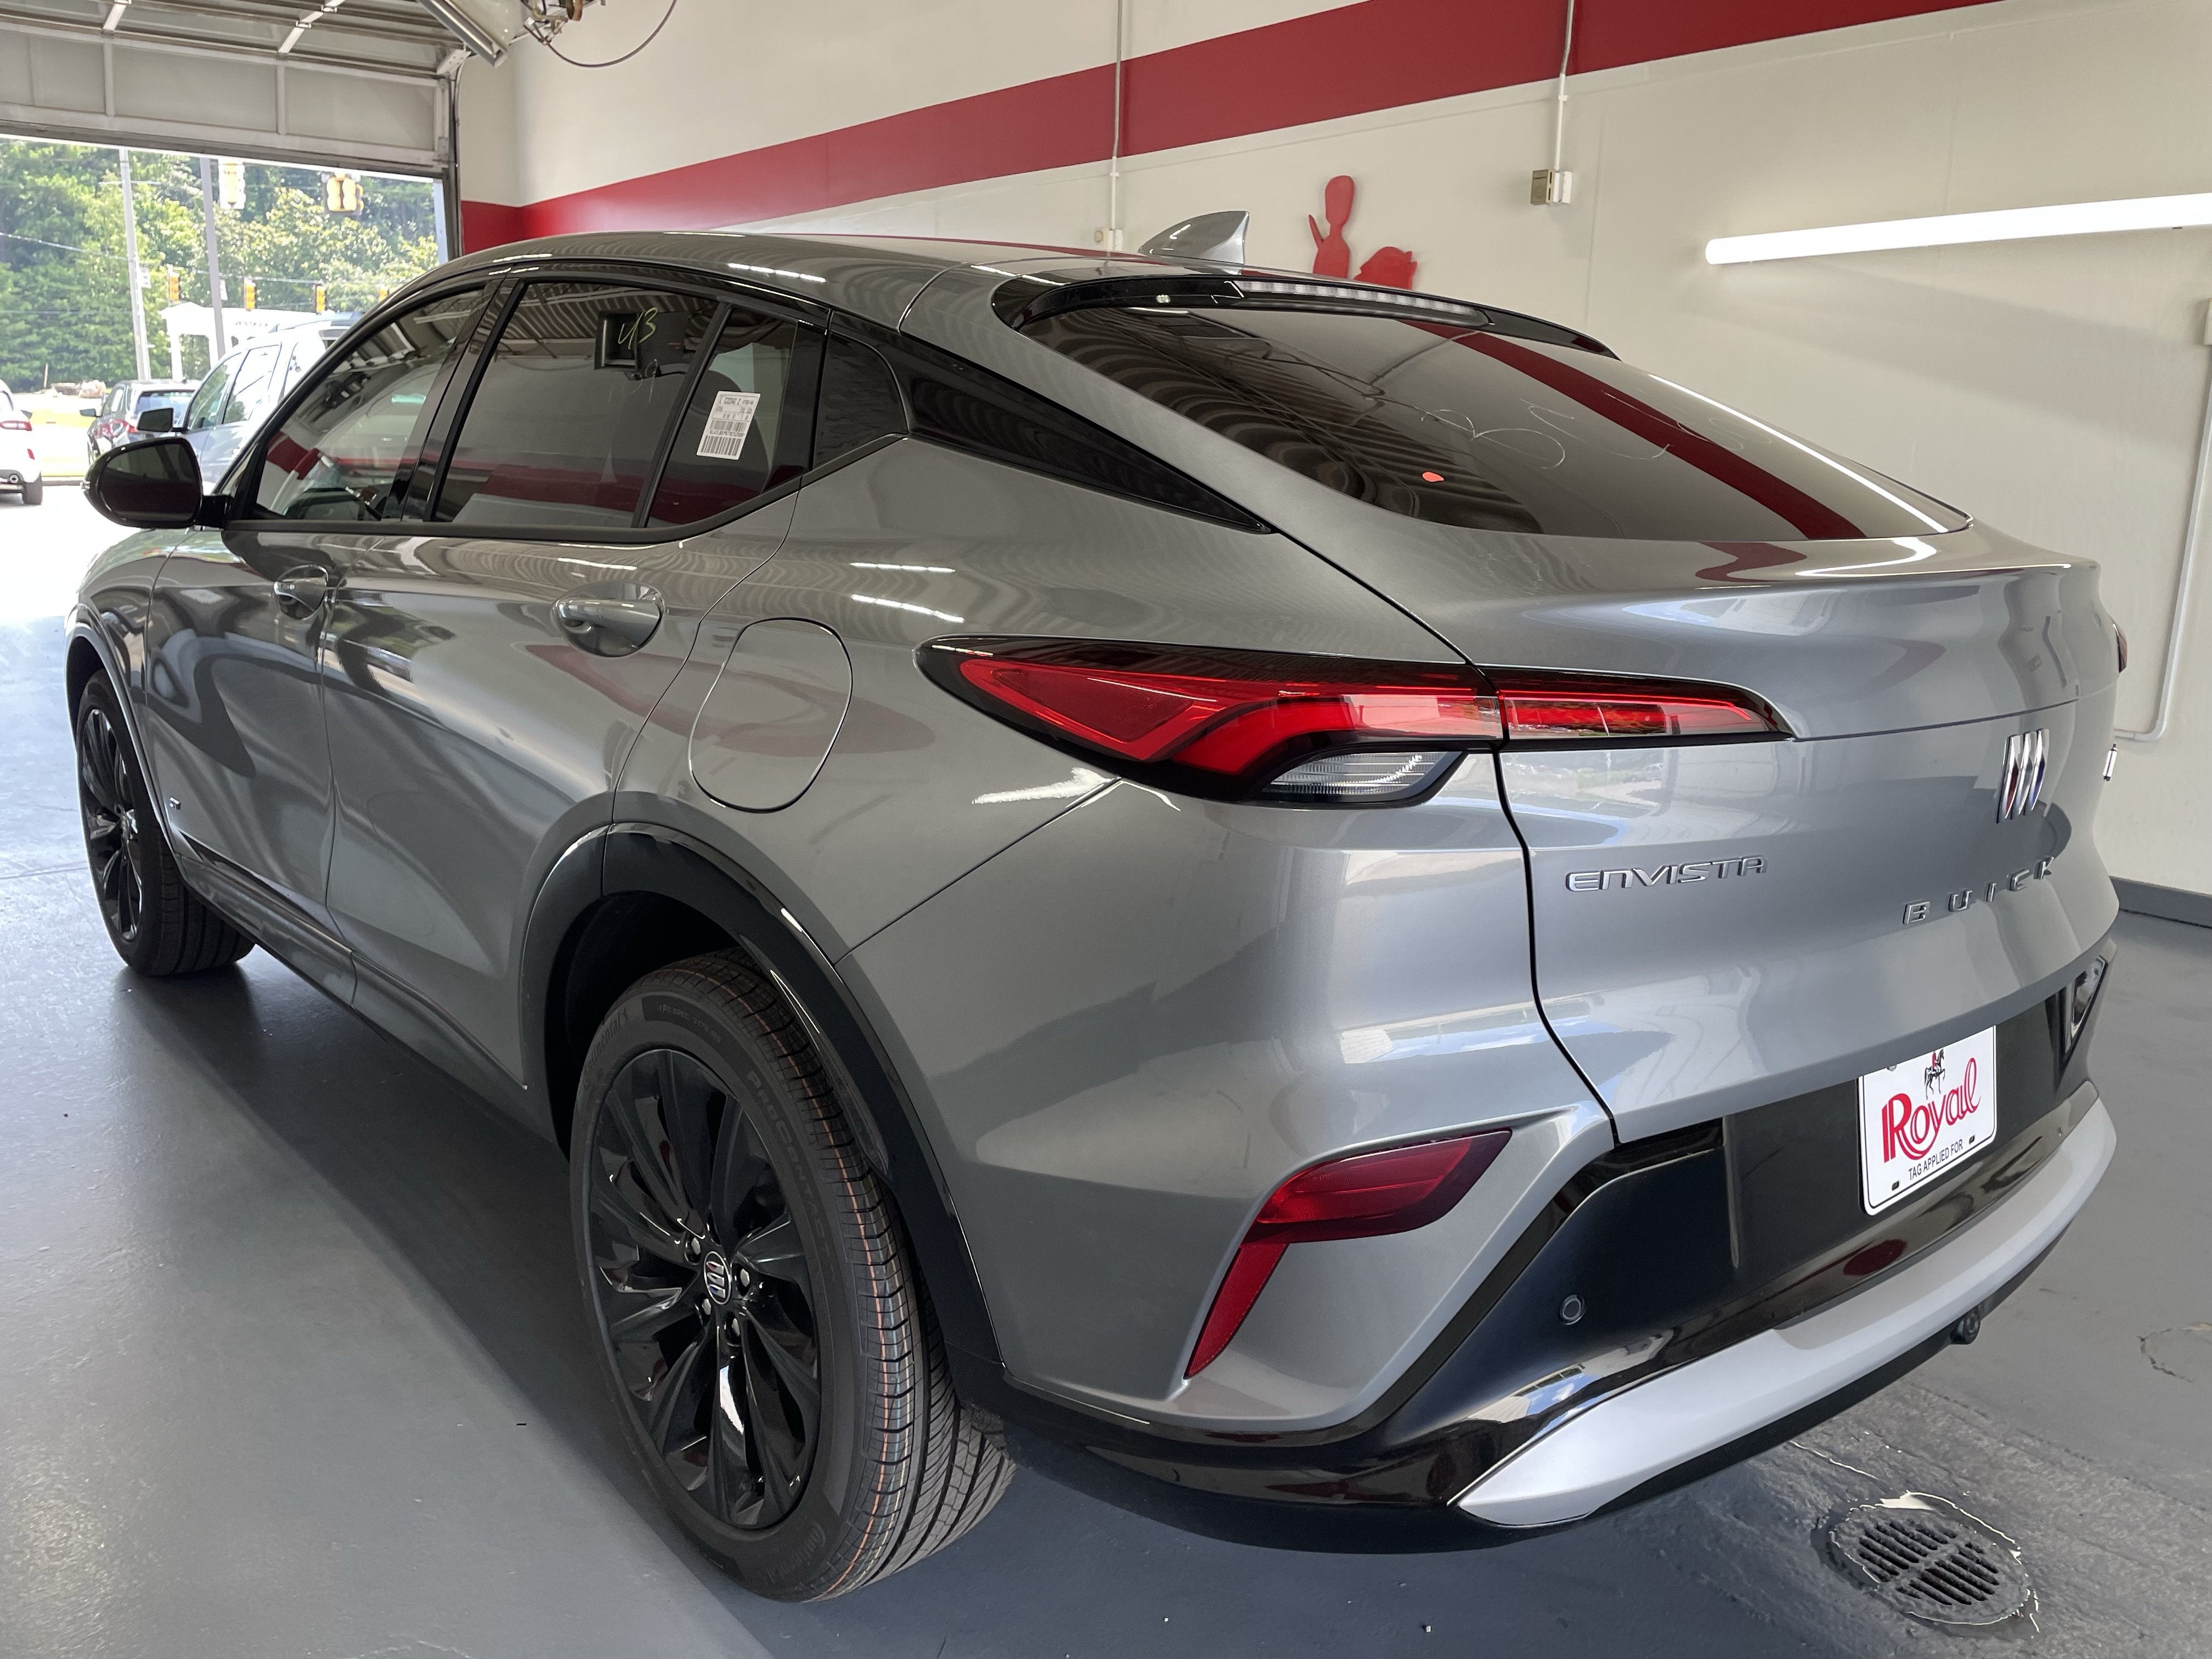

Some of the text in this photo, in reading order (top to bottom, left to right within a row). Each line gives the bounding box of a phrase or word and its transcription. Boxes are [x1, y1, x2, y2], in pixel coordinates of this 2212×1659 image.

[1566, 854, 1768, 893] ENVISTA
[1903, 855, 2056, 925] BUICK
[1882, 1058, 1981, 1163] Royal
[1908, 1139, 1963, 1181] TAG APPLIED FOR
